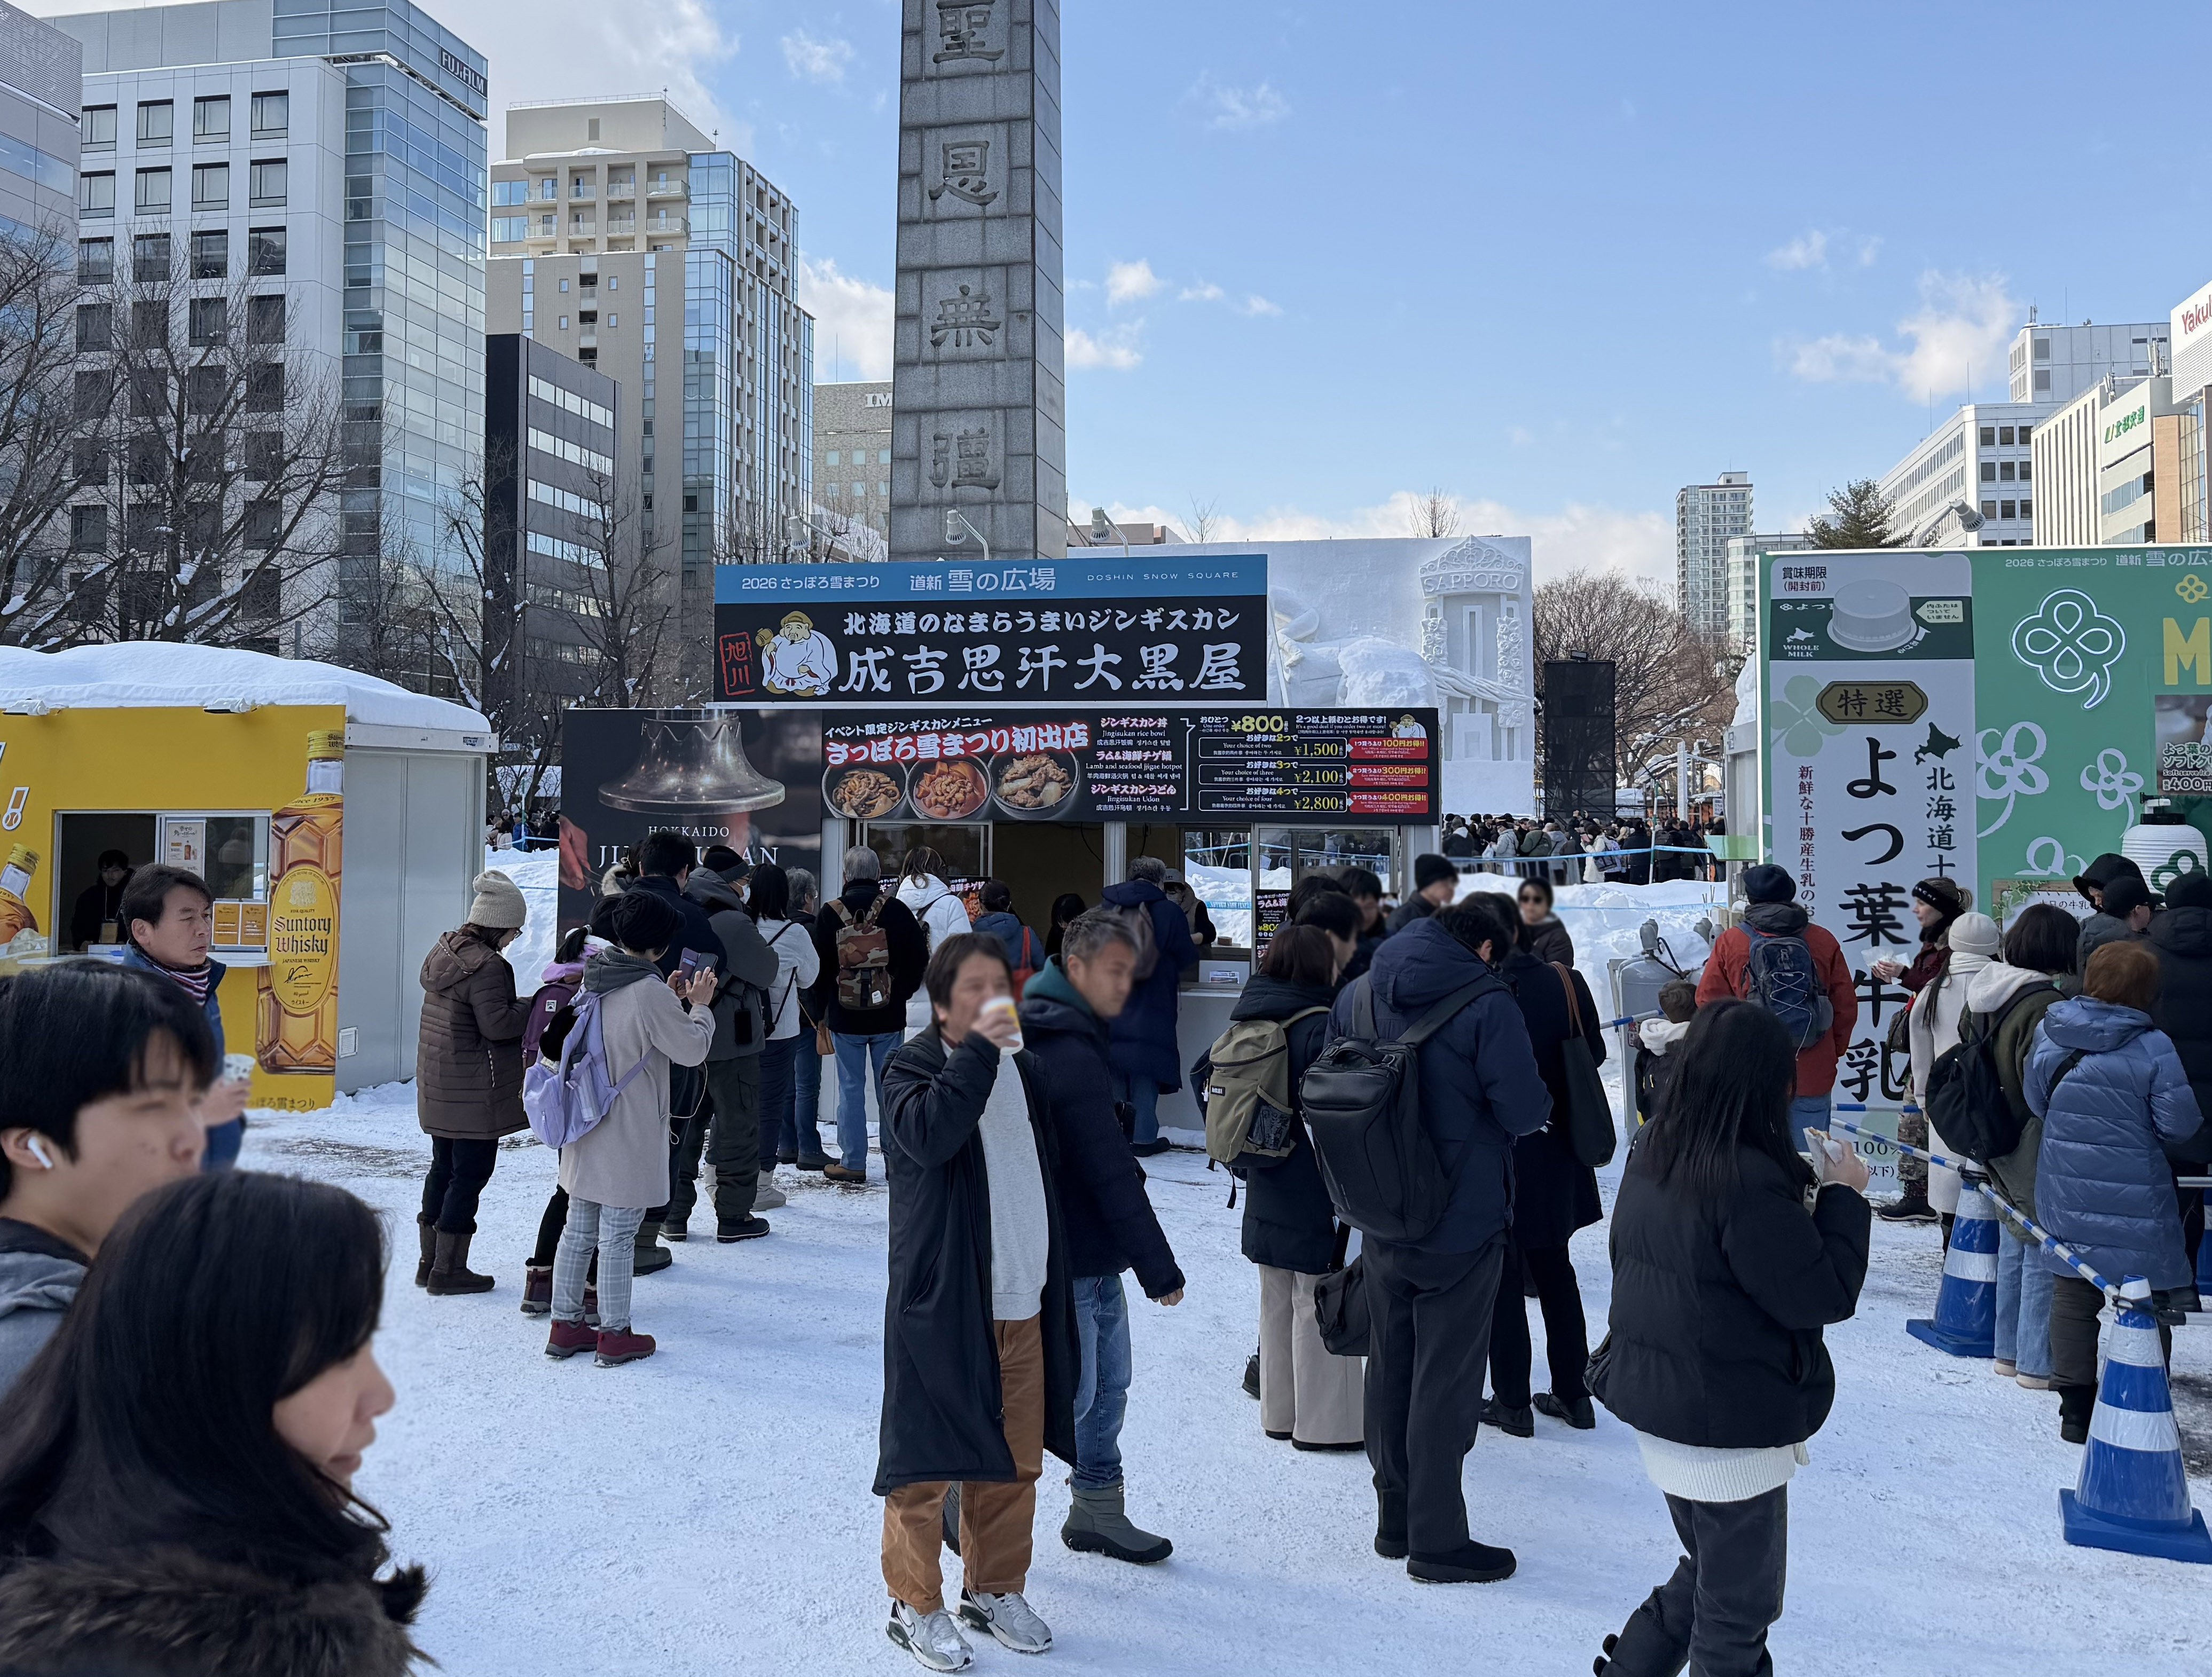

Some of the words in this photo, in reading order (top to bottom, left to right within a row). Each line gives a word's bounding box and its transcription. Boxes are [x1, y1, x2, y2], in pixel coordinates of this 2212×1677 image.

[443, 51, 483, 93] FUJIFILM
[2182, 295, 2212, 334] Yakul
[2006, 559, 2034, 567] 2026
[2038, 557, 2107, 566] さっぽろ雪まつり
[2116, 555, 2142, 566] 道新
[2146, 549, 2212, 566] 雪の広
[742, 578, 776, 589] 2026
[781, 576, 880, 589] さっぽろ雪まつり
[911, 575, 942, 591] 道新
[948, 568, 1056, 592] 雪の広場
[1783, 566, 1827, 579] 賞味期限
[1423, 573, 1518, 593] SAPPORO
[1784, 581, 1825, 592] (開封前)
[844, 608, 1240, 635] 北海道のなまらうまいジンギスカン
[726, 640, 750, 687] 旭川
[838, 642, 1247, 695] 成吉思汗大黒屋
[1837, 689, 1908, 717] 特選
[825, 717, 992, 738] イベント限定ジンギスカンメニュー
[1231, 715, 1284, 732] ¥800
[826, 722, 1089, 765] さっぽろ雪まつり初出店
[1294, 743, 1338, 757] ¥1,500
[2163, 743, 2211, 755] よつ葉の
[1162, 763, 1182, 771] hotpot
[1295, 770, 1339, 784] ¥2,100
[1091, 784, 1176, 794] ジンギスカンうどん
[1295, 797, 1339, 810] ¥2,800
[1798, 765, 1816, 917] 新鮮な十勝産生乳のお
[2039, 900, 2089, 910] 日の牛乳
[274, 916, 331, 935] Suntory
[1839, 737, 1911, 1102] よつ葉牛乳
[277, 934, 328, 955] Whisky
